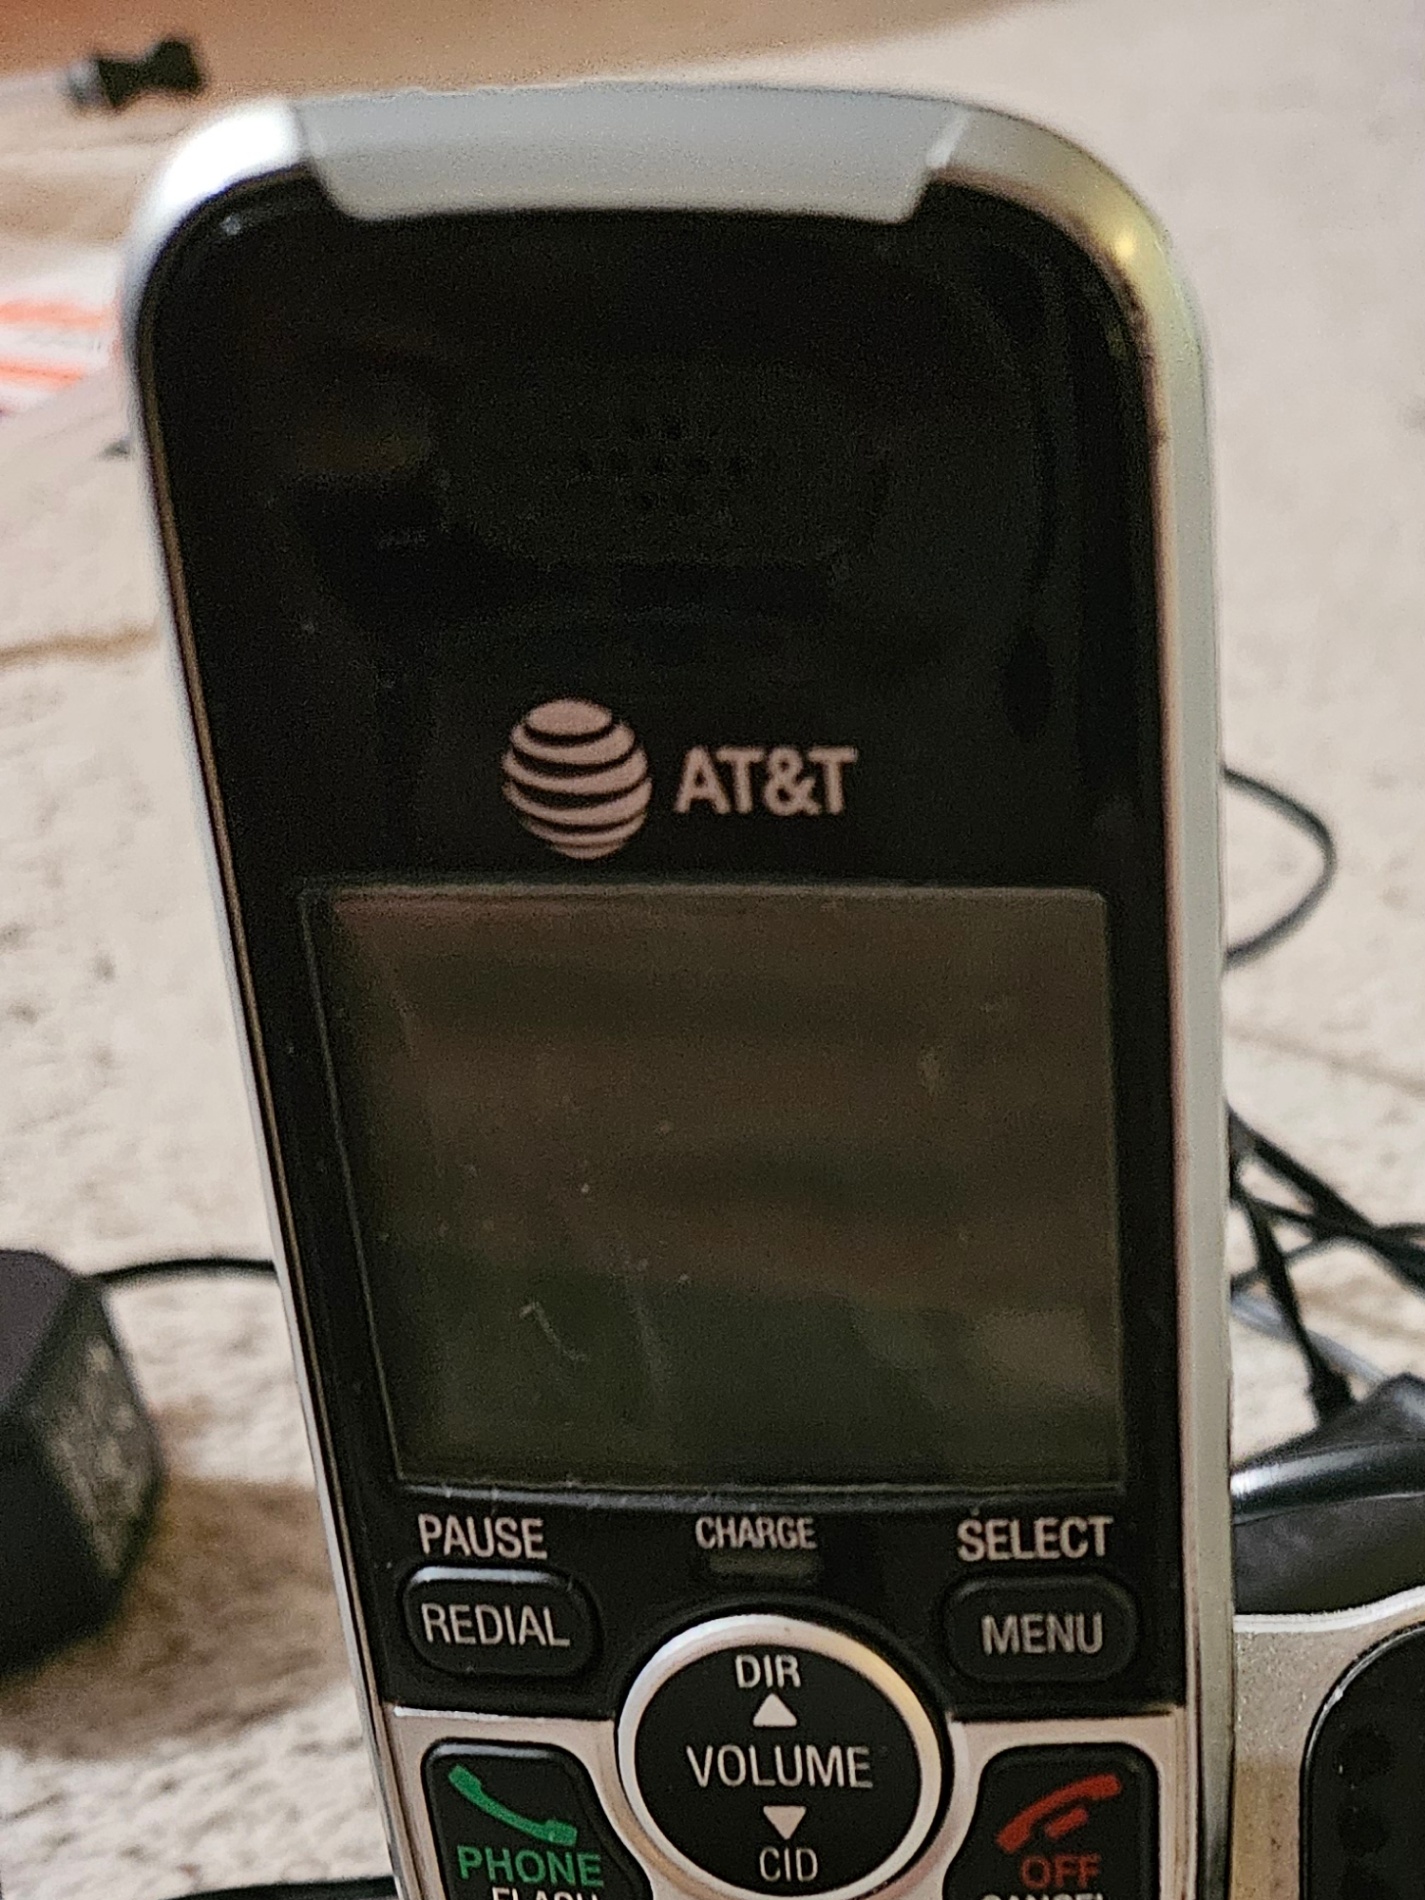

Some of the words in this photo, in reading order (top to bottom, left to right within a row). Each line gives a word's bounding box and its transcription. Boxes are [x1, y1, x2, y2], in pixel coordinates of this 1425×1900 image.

[675, 746, 858, 816] AT&T
[417, 1513, 548, 1560] PAUSE
[694, 1515, 818, 1550] CHARGE
[957, 1515, 1114, 1562] SELECT
[421, 1603, 570, 1647] REDIAL
[981, 1612, 1103, 1655] MENU
[735, 1654, 801, 1688] DIR
[686, 1744, 873, 1788] VOLUME
[456, 1844, 605, 1888] PHONE
[759, 1847, 818, 1881] CID
[1020, 1853, 1101, 1890] OFF
